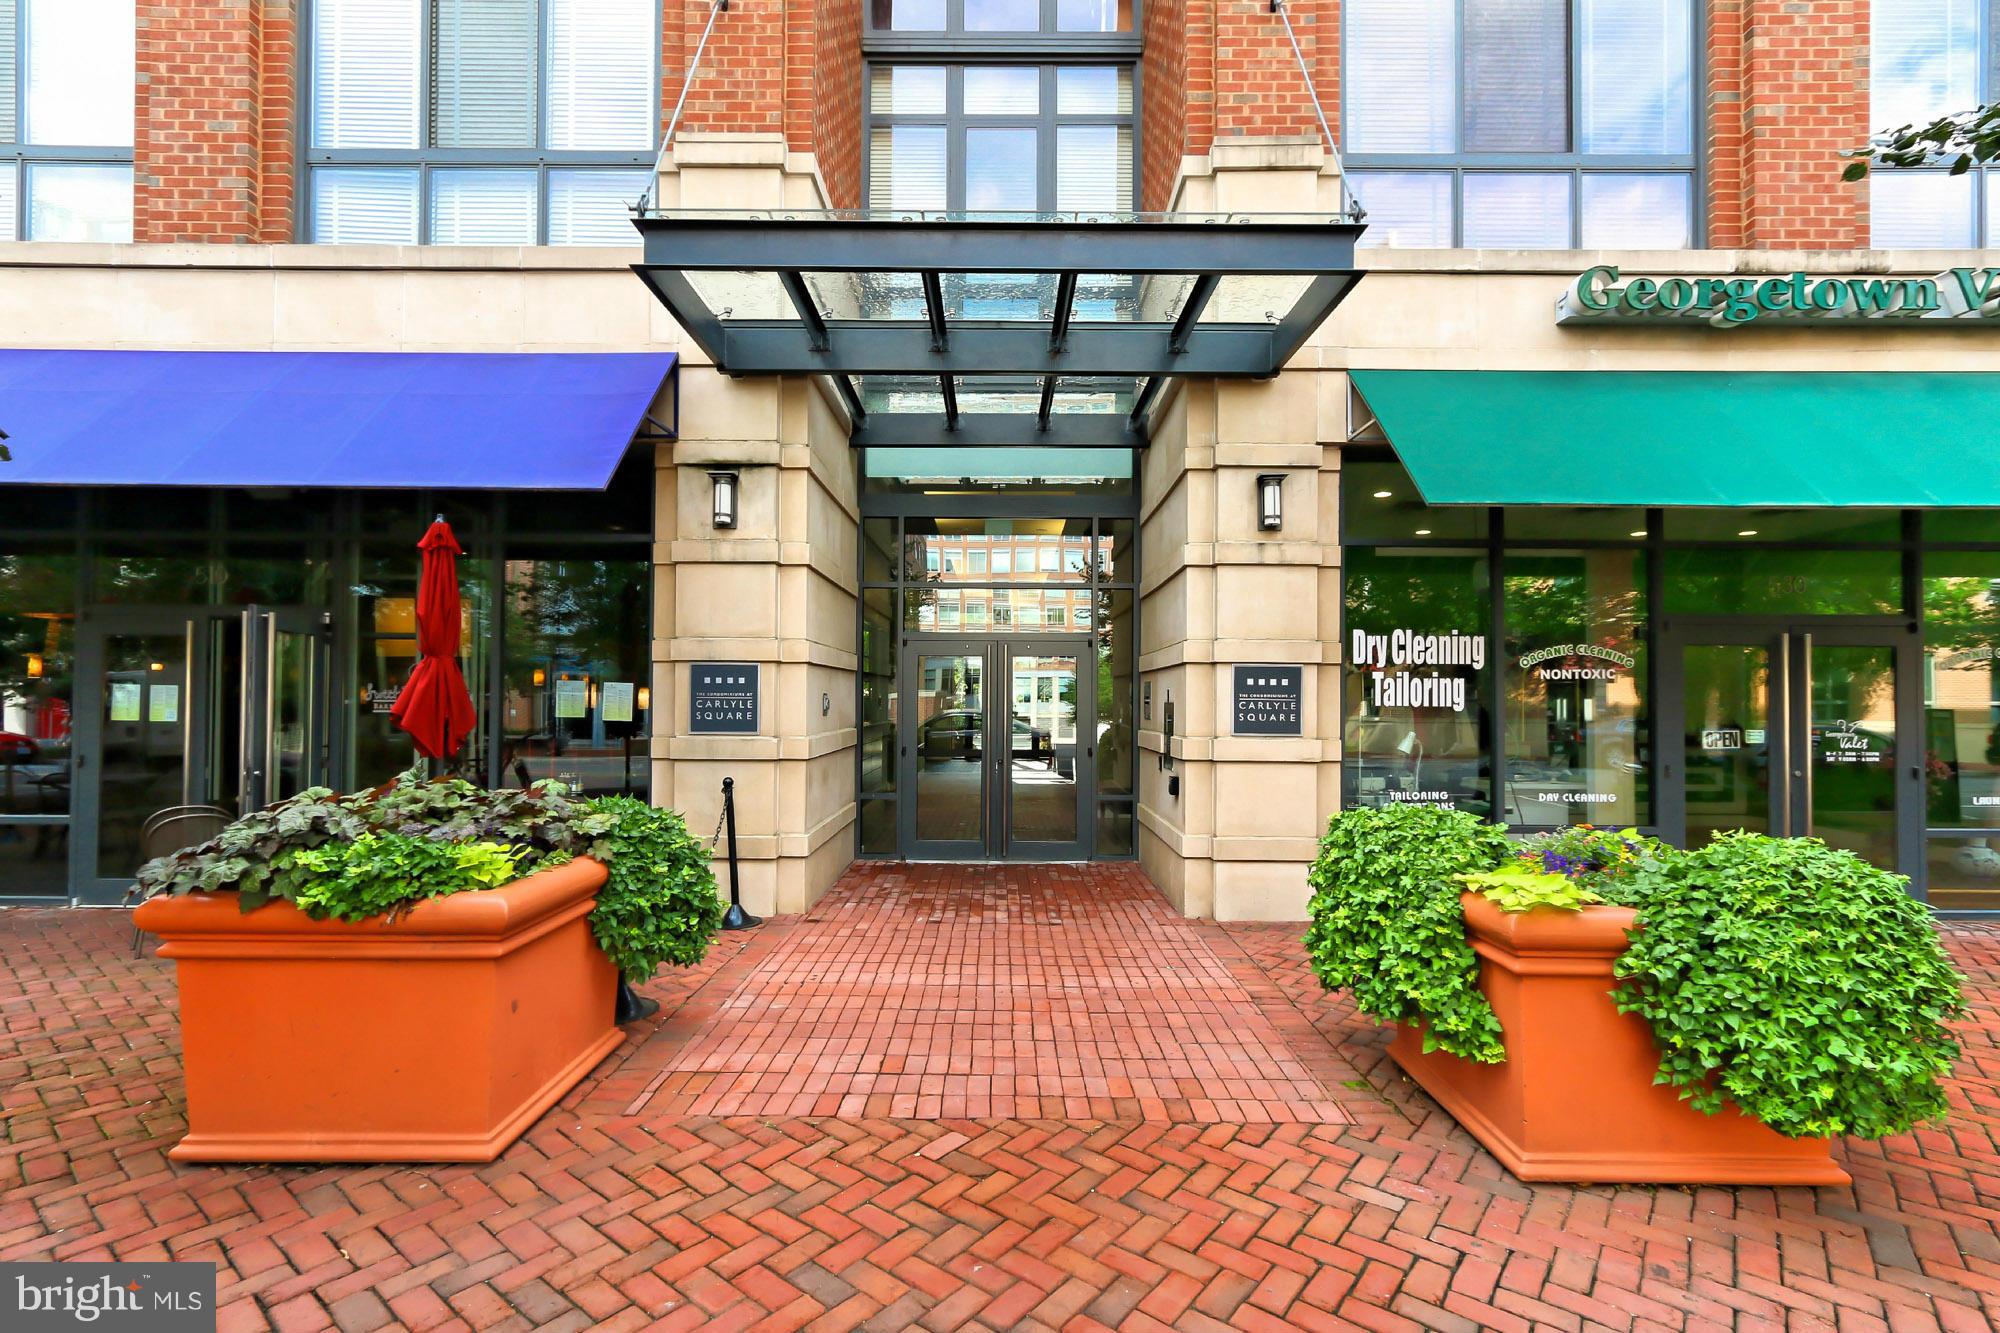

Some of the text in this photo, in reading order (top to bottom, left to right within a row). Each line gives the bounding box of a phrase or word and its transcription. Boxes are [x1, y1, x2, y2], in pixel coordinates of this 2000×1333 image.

[1577, 265, 1940, 322] Georgetown
[1353, 629, 1485, 670] Dry Cleaning
[1520, 644, 1635, 668] ORGANIC CLEANING
[1540, 669, 1616, 679] NONTOXIC
[1372, 671, 1465, 712] Tailoring
[696, 700, 753, 709] CARLYLE
[1239, 701, 1297, 710] CARLYLE
[696, 711, 752, 720] SQUARE
[1239, 713, 1296, 721] SQUARE
[1705, 731, 1738, 748] OPEN
[1840, 736, 1868, 750] Valet
[1389, 791, 1449, 800] TAILORING
[1562, 793, 1617, 802] CLEANING
